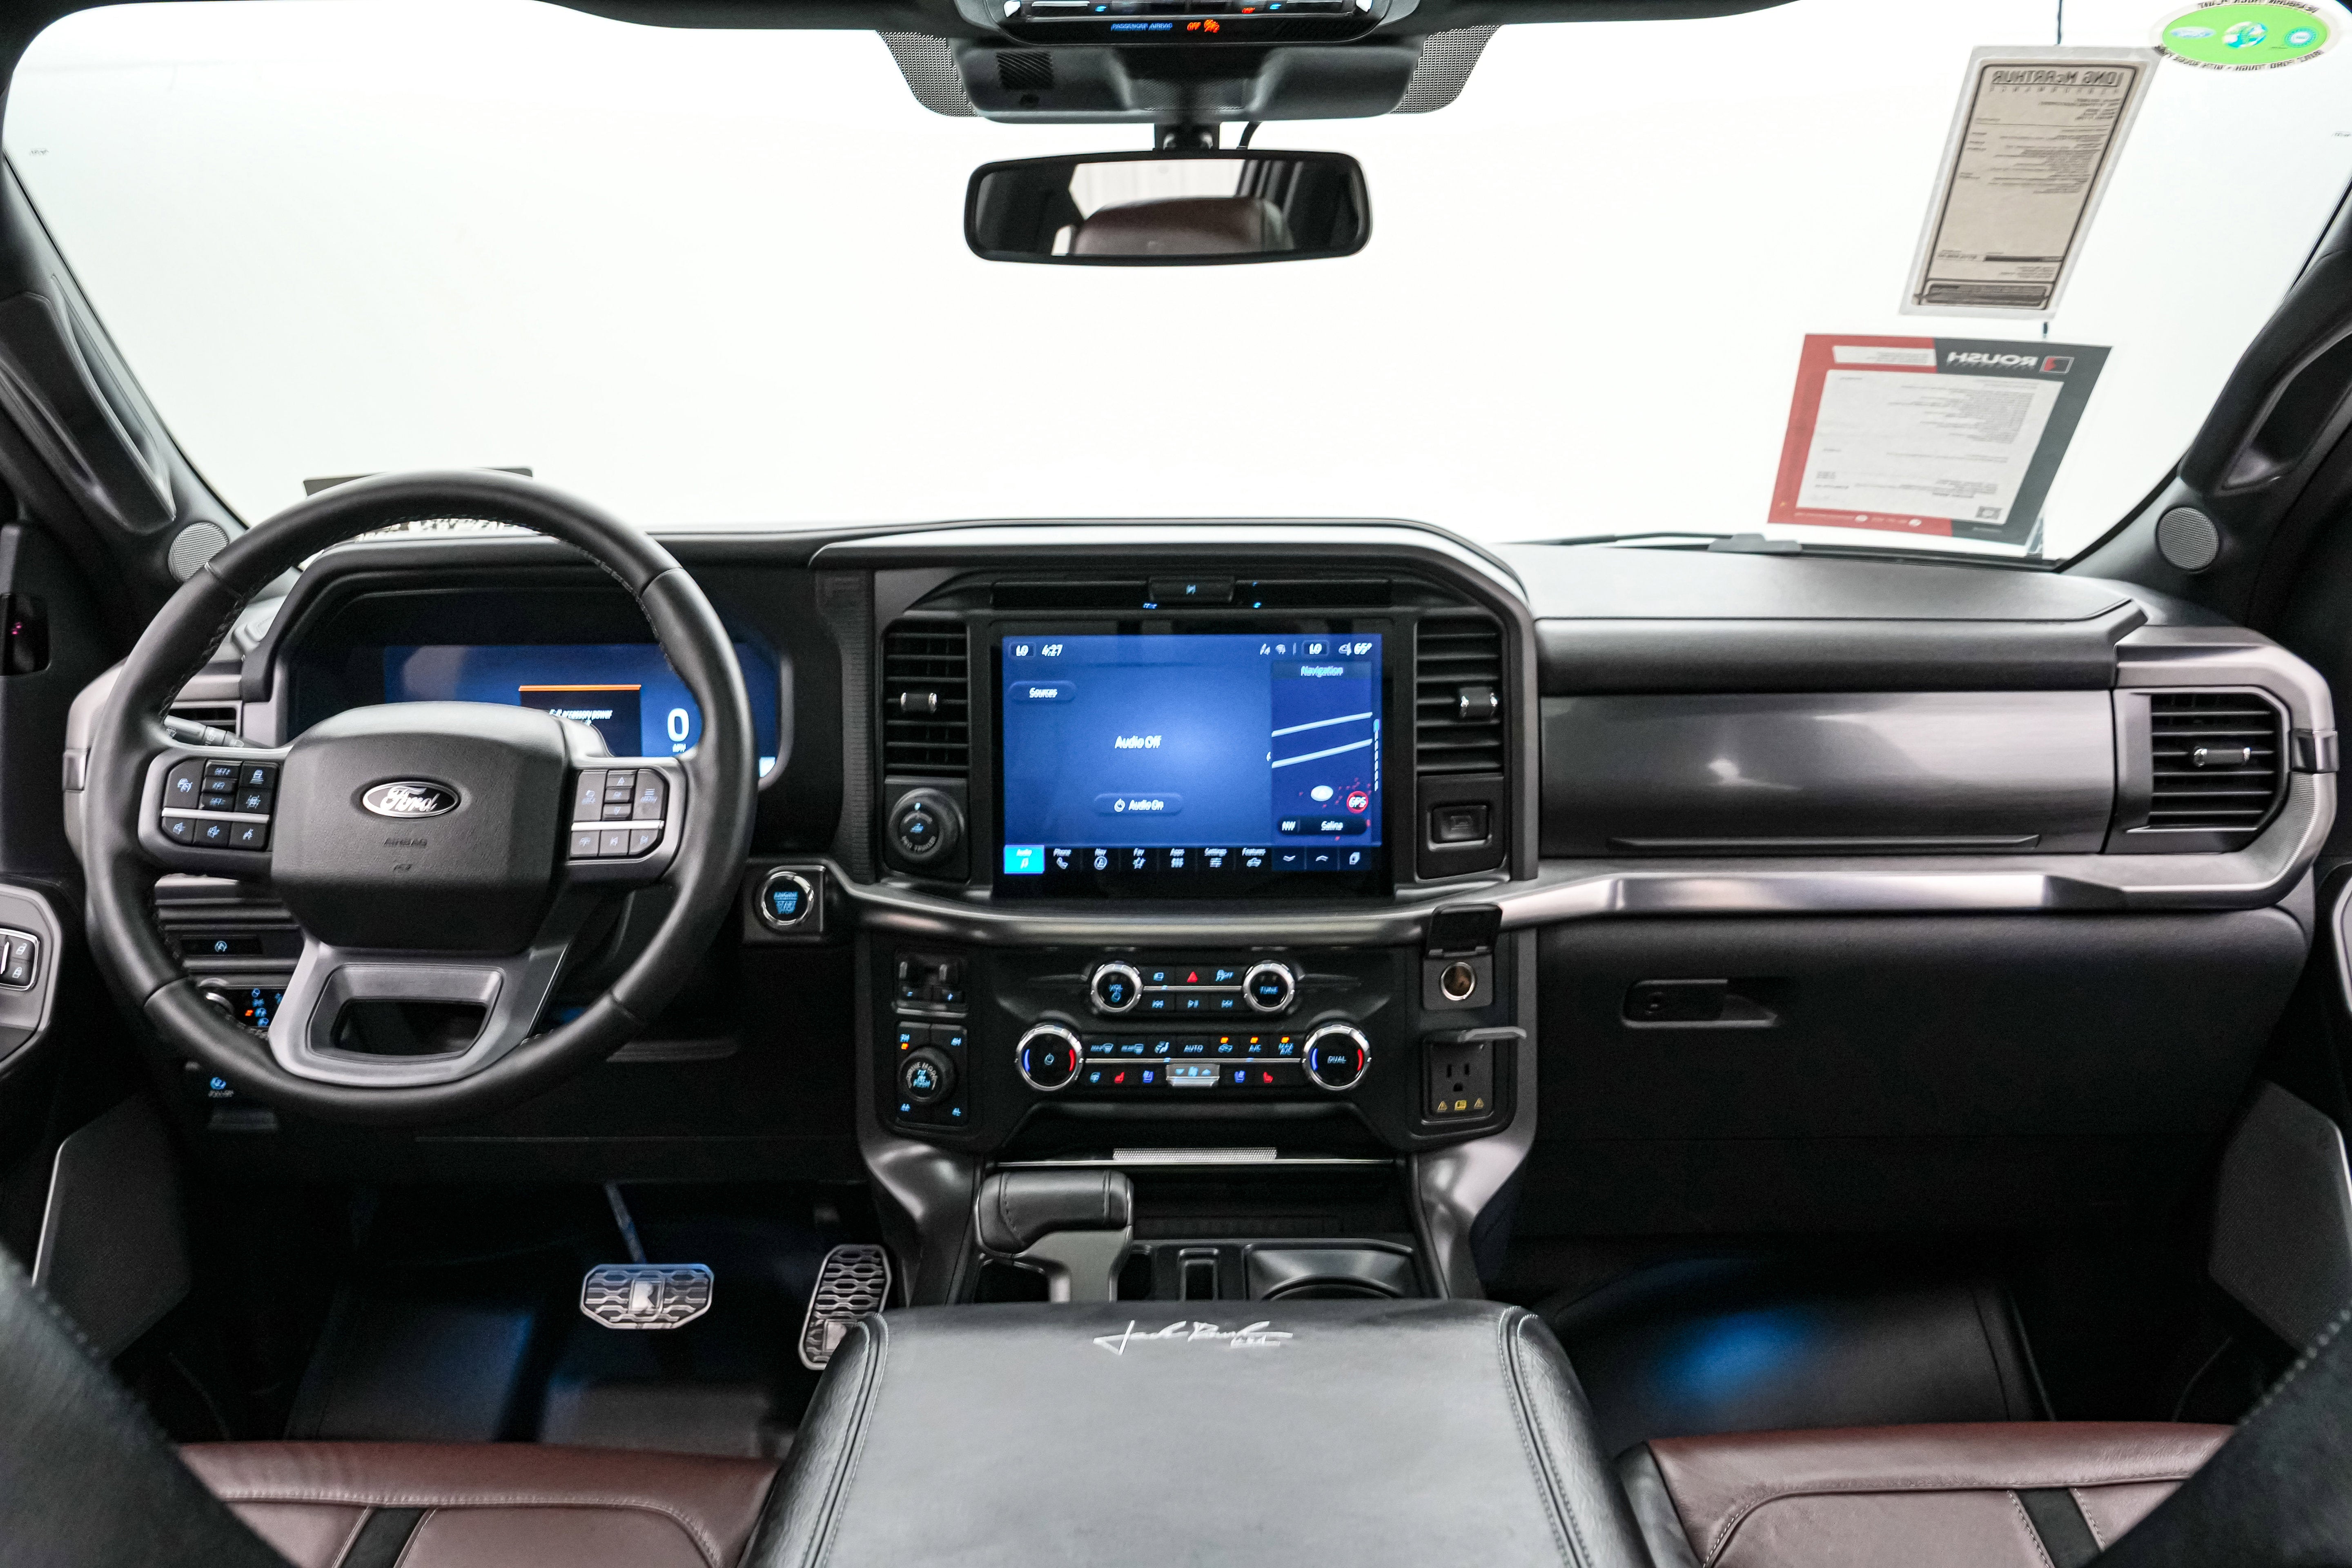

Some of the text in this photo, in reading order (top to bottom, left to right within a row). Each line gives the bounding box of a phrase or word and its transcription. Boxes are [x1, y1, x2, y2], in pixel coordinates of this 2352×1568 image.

[1041, 644, 1063, 657] 4:27
[1301, 666, 1343, 677] Navigation
[1029, 687, 1058, 699] Sources
[591, 710, 612, 720] power
[667, 708, 690, 742] 0
[1115, 735, 1162, 749] Audio Off
[672, 743, 686, 753] MPH
[380, 786, 441, 812] Ford
[1128, 800, 1164, 811] Audio On
[1281, 821, 1296, 831] NW
[1053, 848, 1071, 857] Phone
[1183, 1045, 1204, 1053] AUTO
[1248, 1045, 1262, 1053] A/C
[1327, 1056, 1347, 1064] DUAL
